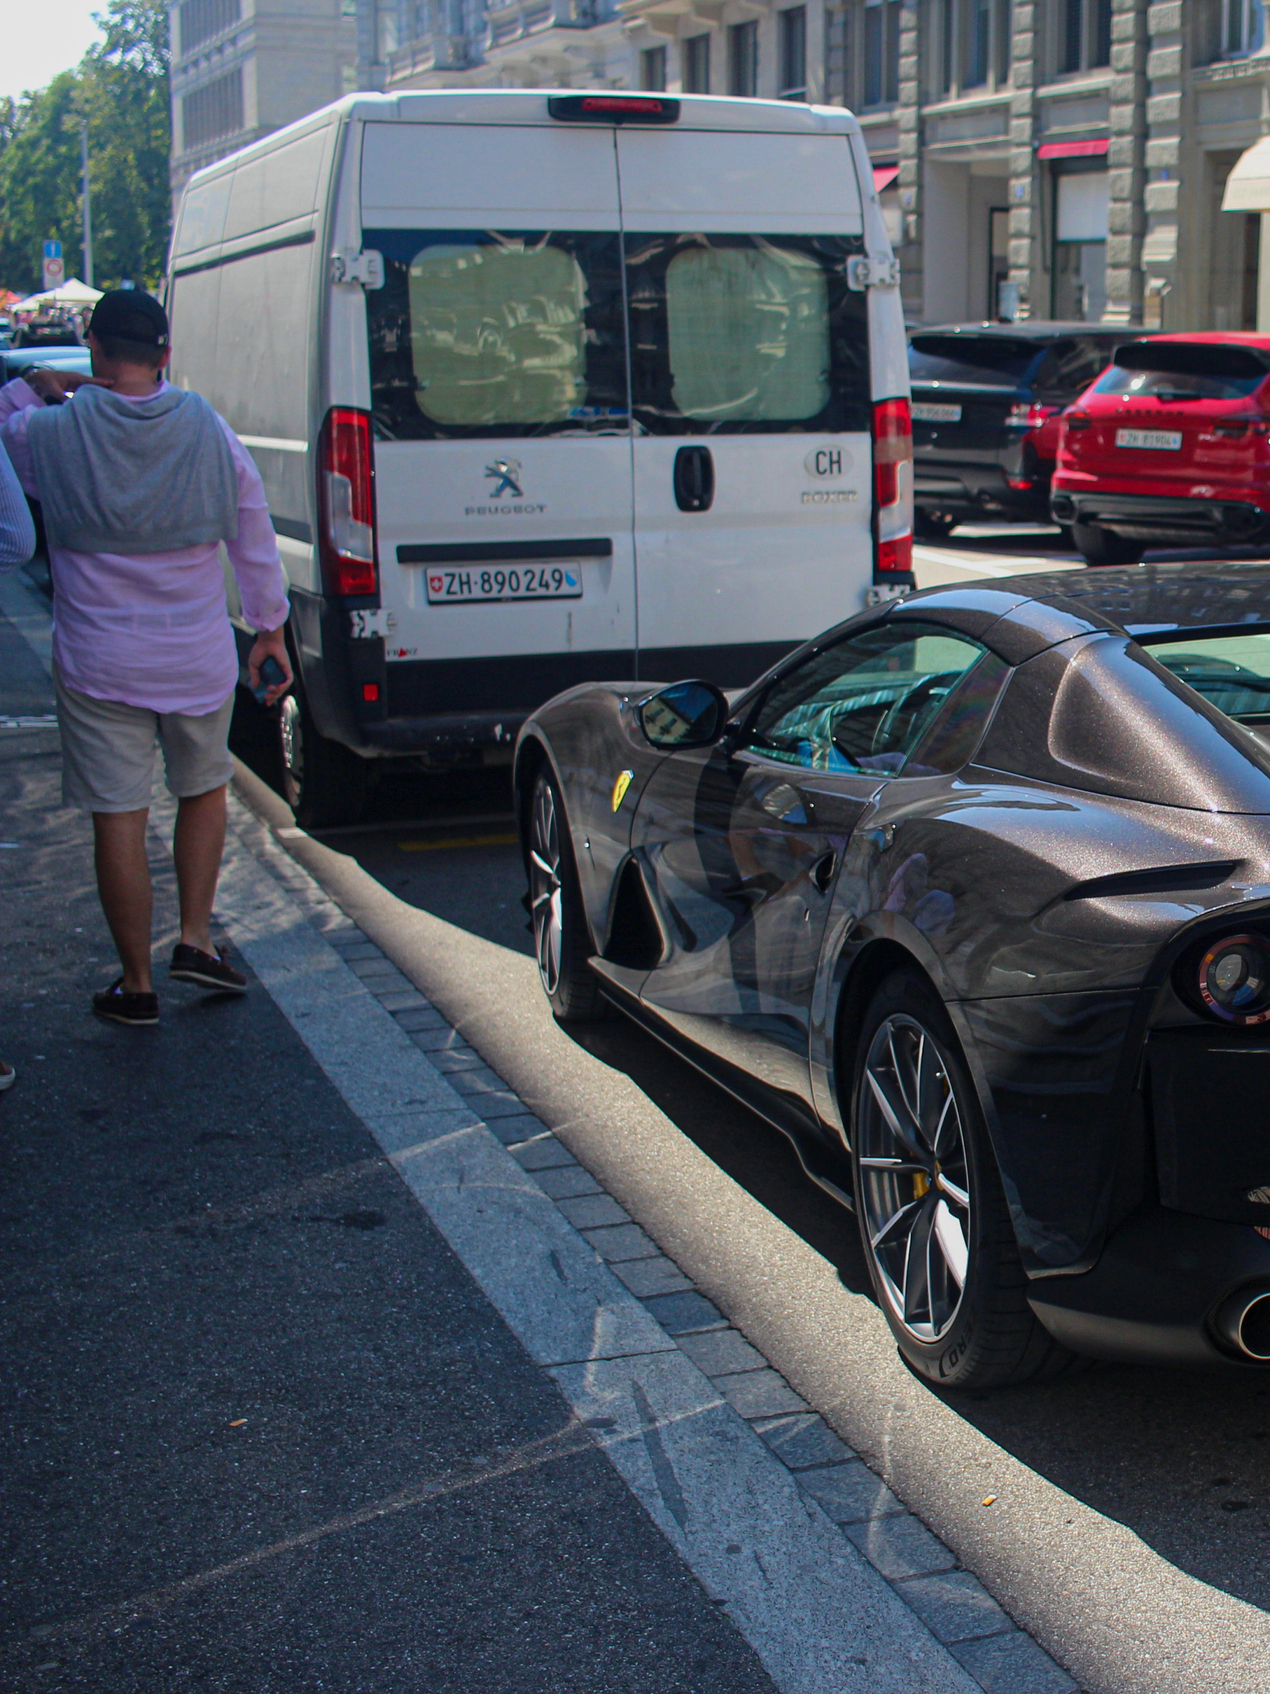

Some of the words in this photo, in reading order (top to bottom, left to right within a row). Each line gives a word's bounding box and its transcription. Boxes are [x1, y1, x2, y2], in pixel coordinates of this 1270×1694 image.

[815, 450, 842, 475] CH
[801, 490, 858, 503] BOXER
[464, 504, 548, 515] PEUGEOT
